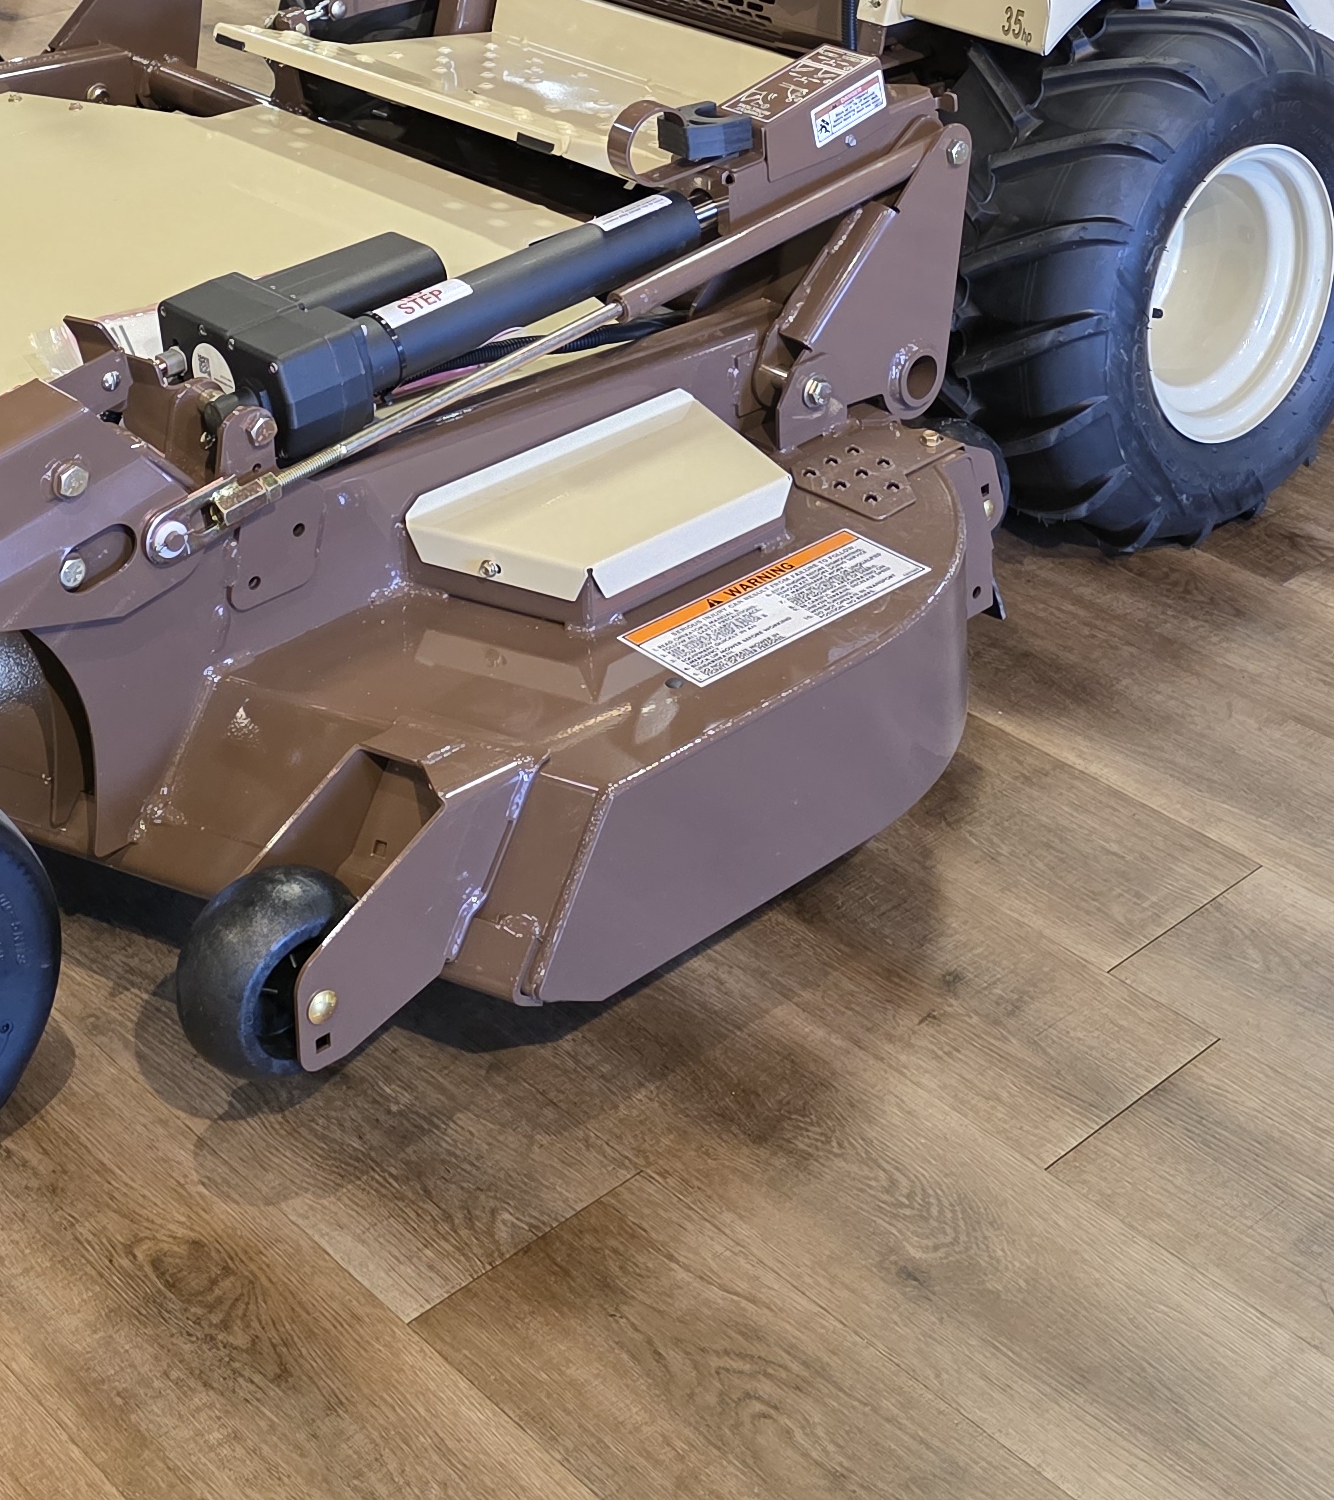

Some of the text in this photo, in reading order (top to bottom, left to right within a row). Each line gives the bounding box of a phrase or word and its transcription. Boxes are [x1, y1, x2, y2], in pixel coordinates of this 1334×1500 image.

[1001, 6, 1033, 44] 35hp
[397, 289, 443, 315] STEP
[721, 561, 796, 598] WARNING
[670, 619, 704, 636] SERIOUS
[701, 607, 728, 621] INJURY
[726, 599, 744, 608] CAN
[742, 587, 770, 601] RESULT
[768, 577, 791, 588] FROM
[789, 563, 819, 578] FAILURE
